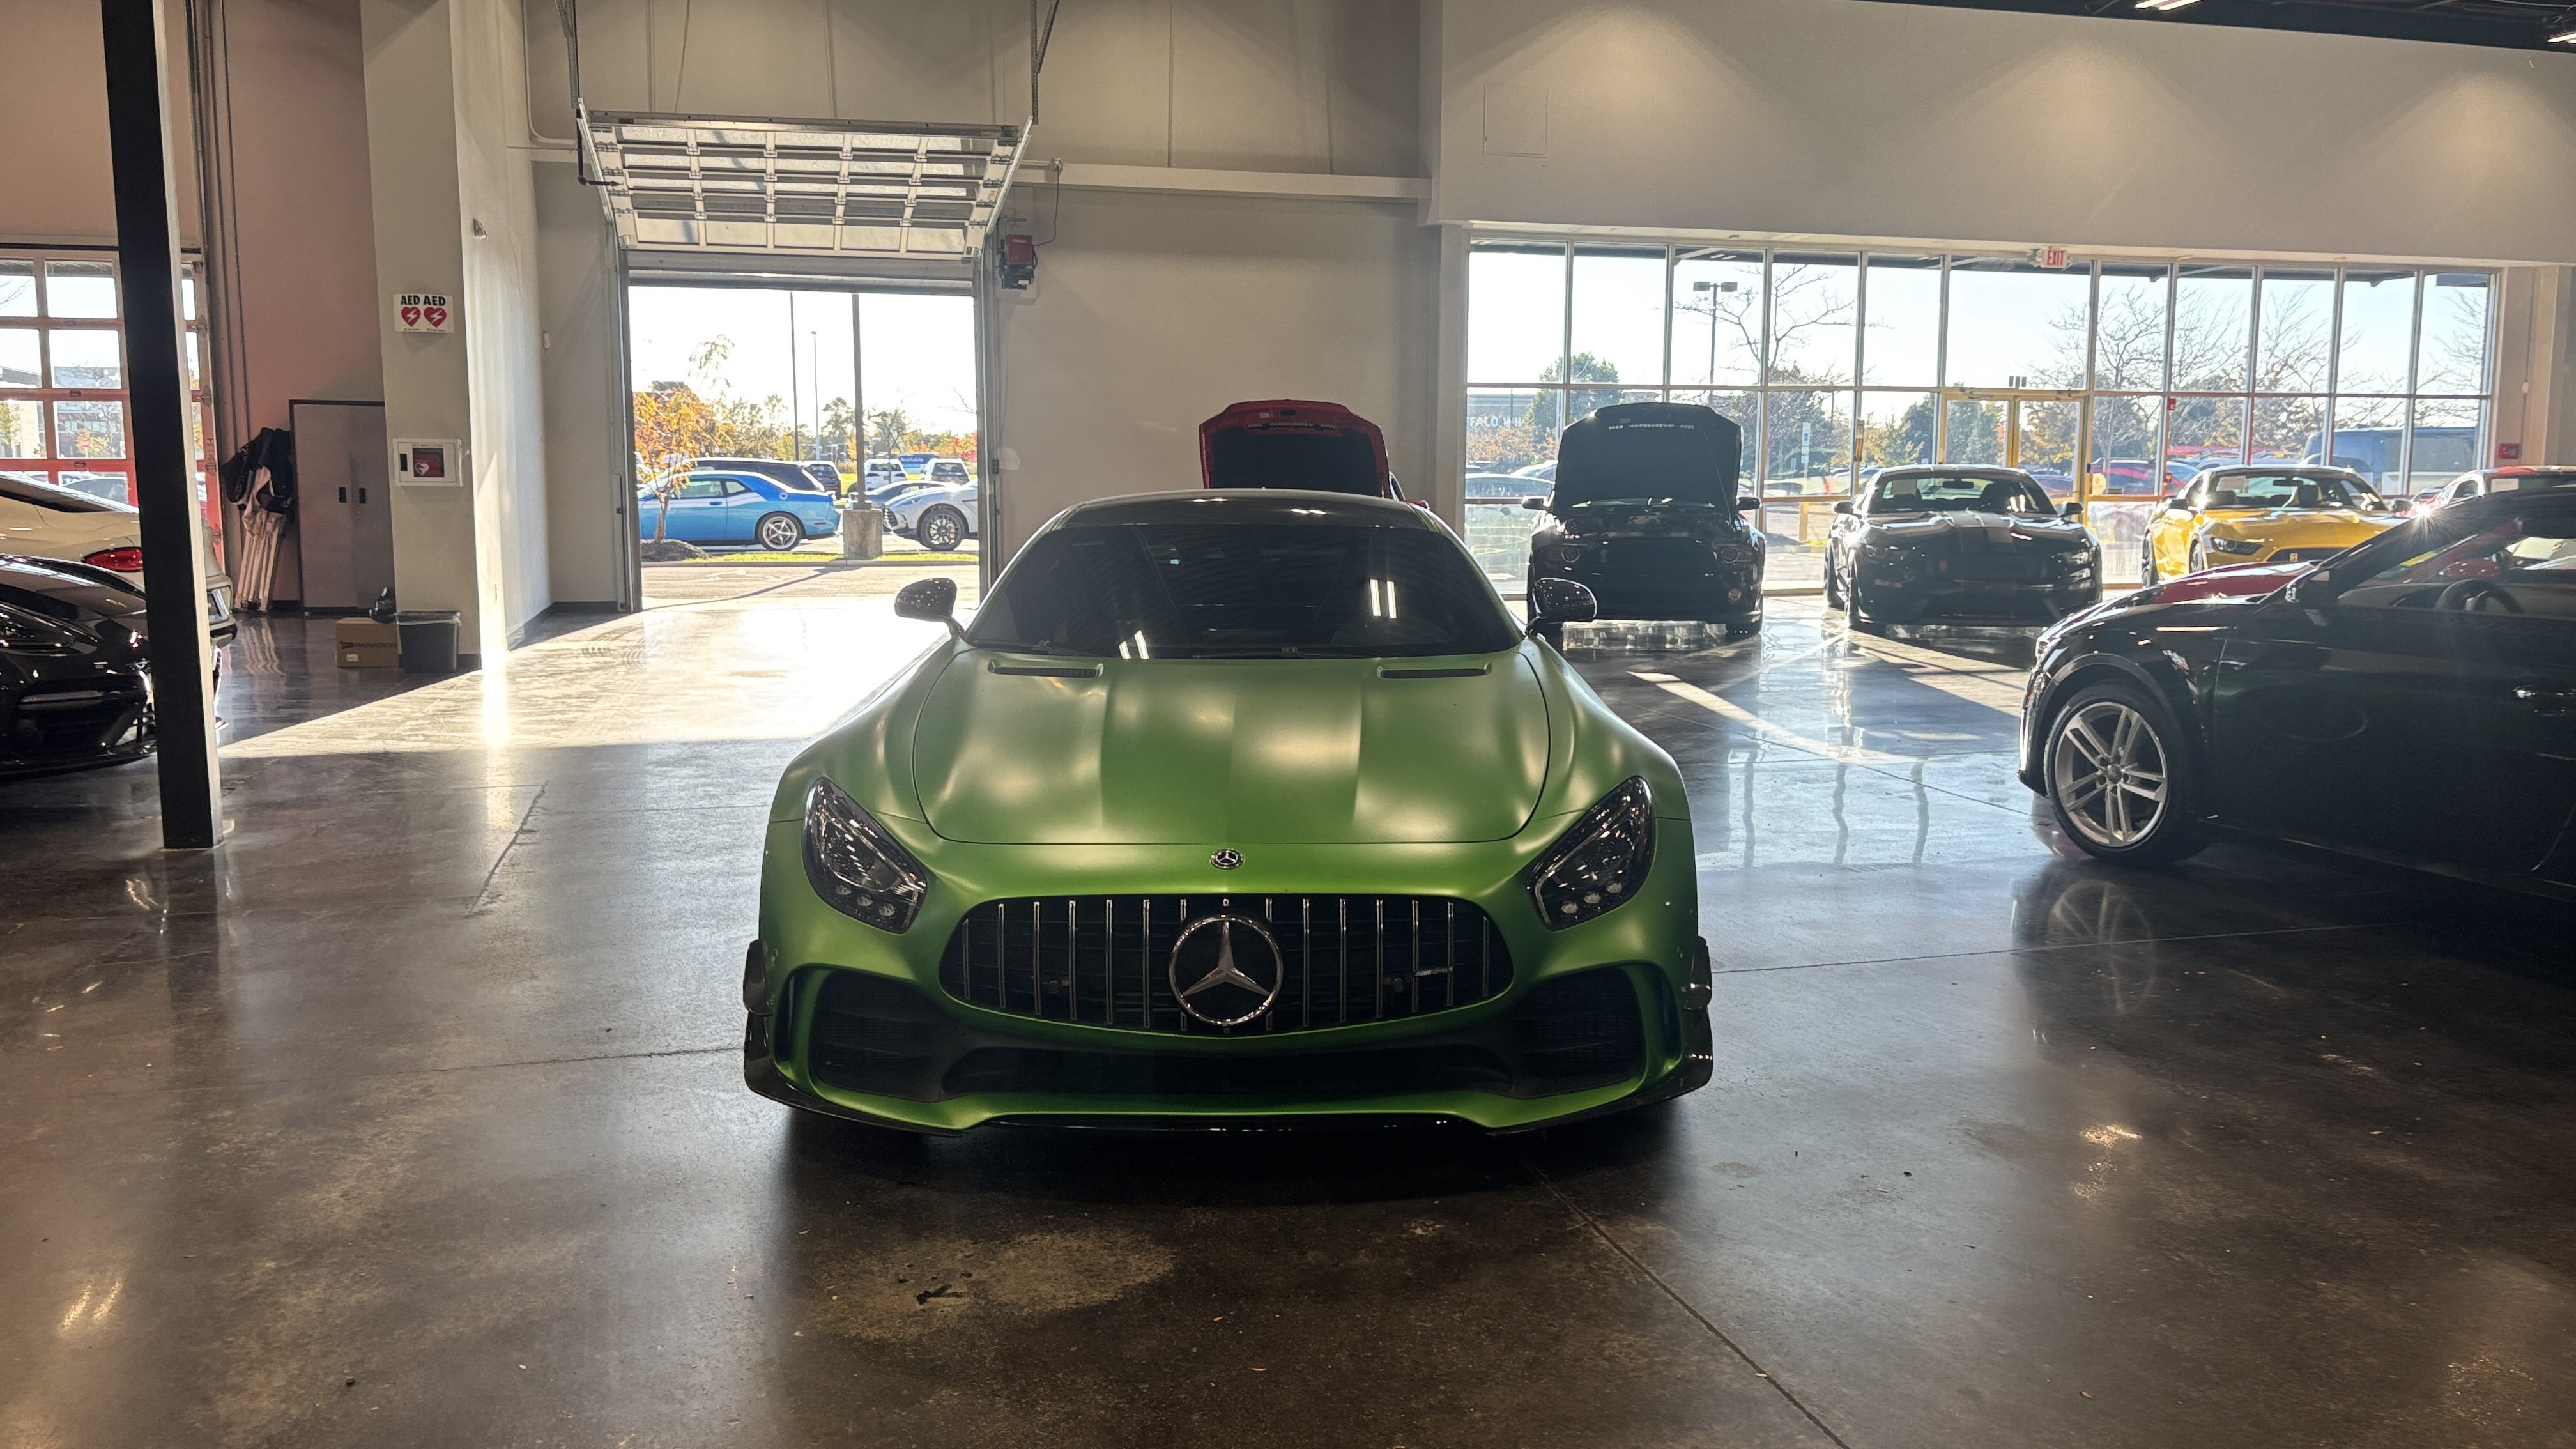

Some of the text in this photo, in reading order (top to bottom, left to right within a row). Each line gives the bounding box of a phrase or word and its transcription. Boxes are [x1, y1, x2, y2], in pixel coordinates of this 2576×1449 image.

[2047, 250, 2065, 266] EXIT
[401, 295, 446, 306] AED AED
